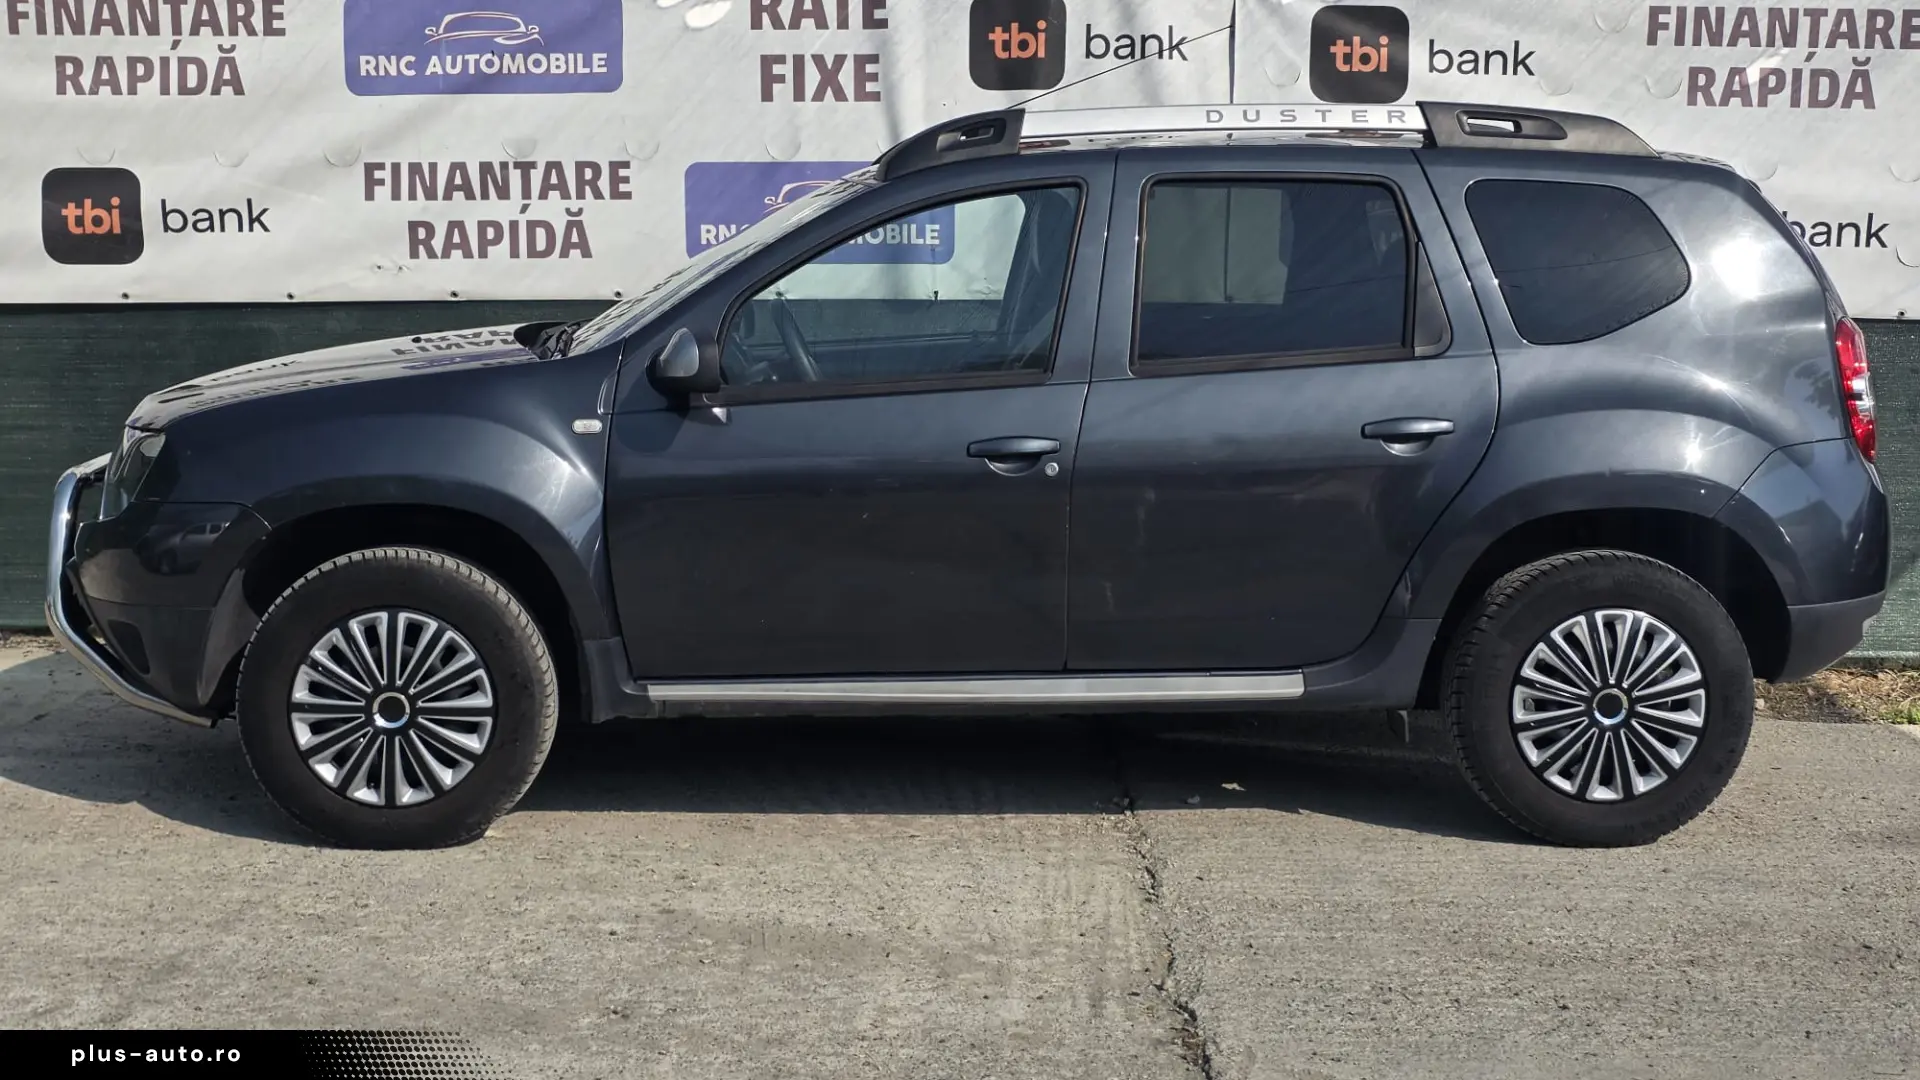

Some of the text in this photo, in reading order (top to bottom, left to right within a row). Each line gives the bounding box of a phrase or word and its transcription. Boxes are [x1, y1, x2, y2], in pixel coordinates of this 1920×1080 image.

[989, 20, 1189, 61] tbi bank
[1330, 36, 1536, 77] tbi bank
[55, 44, 246, 96] RAPIDĂ
[359, 52, 608, 77] RNC AUTOMOBILE
[760, 54, 881, 102] FIXE
[1687, 57, 1876, 109] RAPIDĂ
[1206, 109, 1406, 124] DUSTER
[62, 197, 270, 235] tbi bank
[408, 208, 593, 260] RAPIDĂ
[701, 224, 940, 245] RN OBILE
